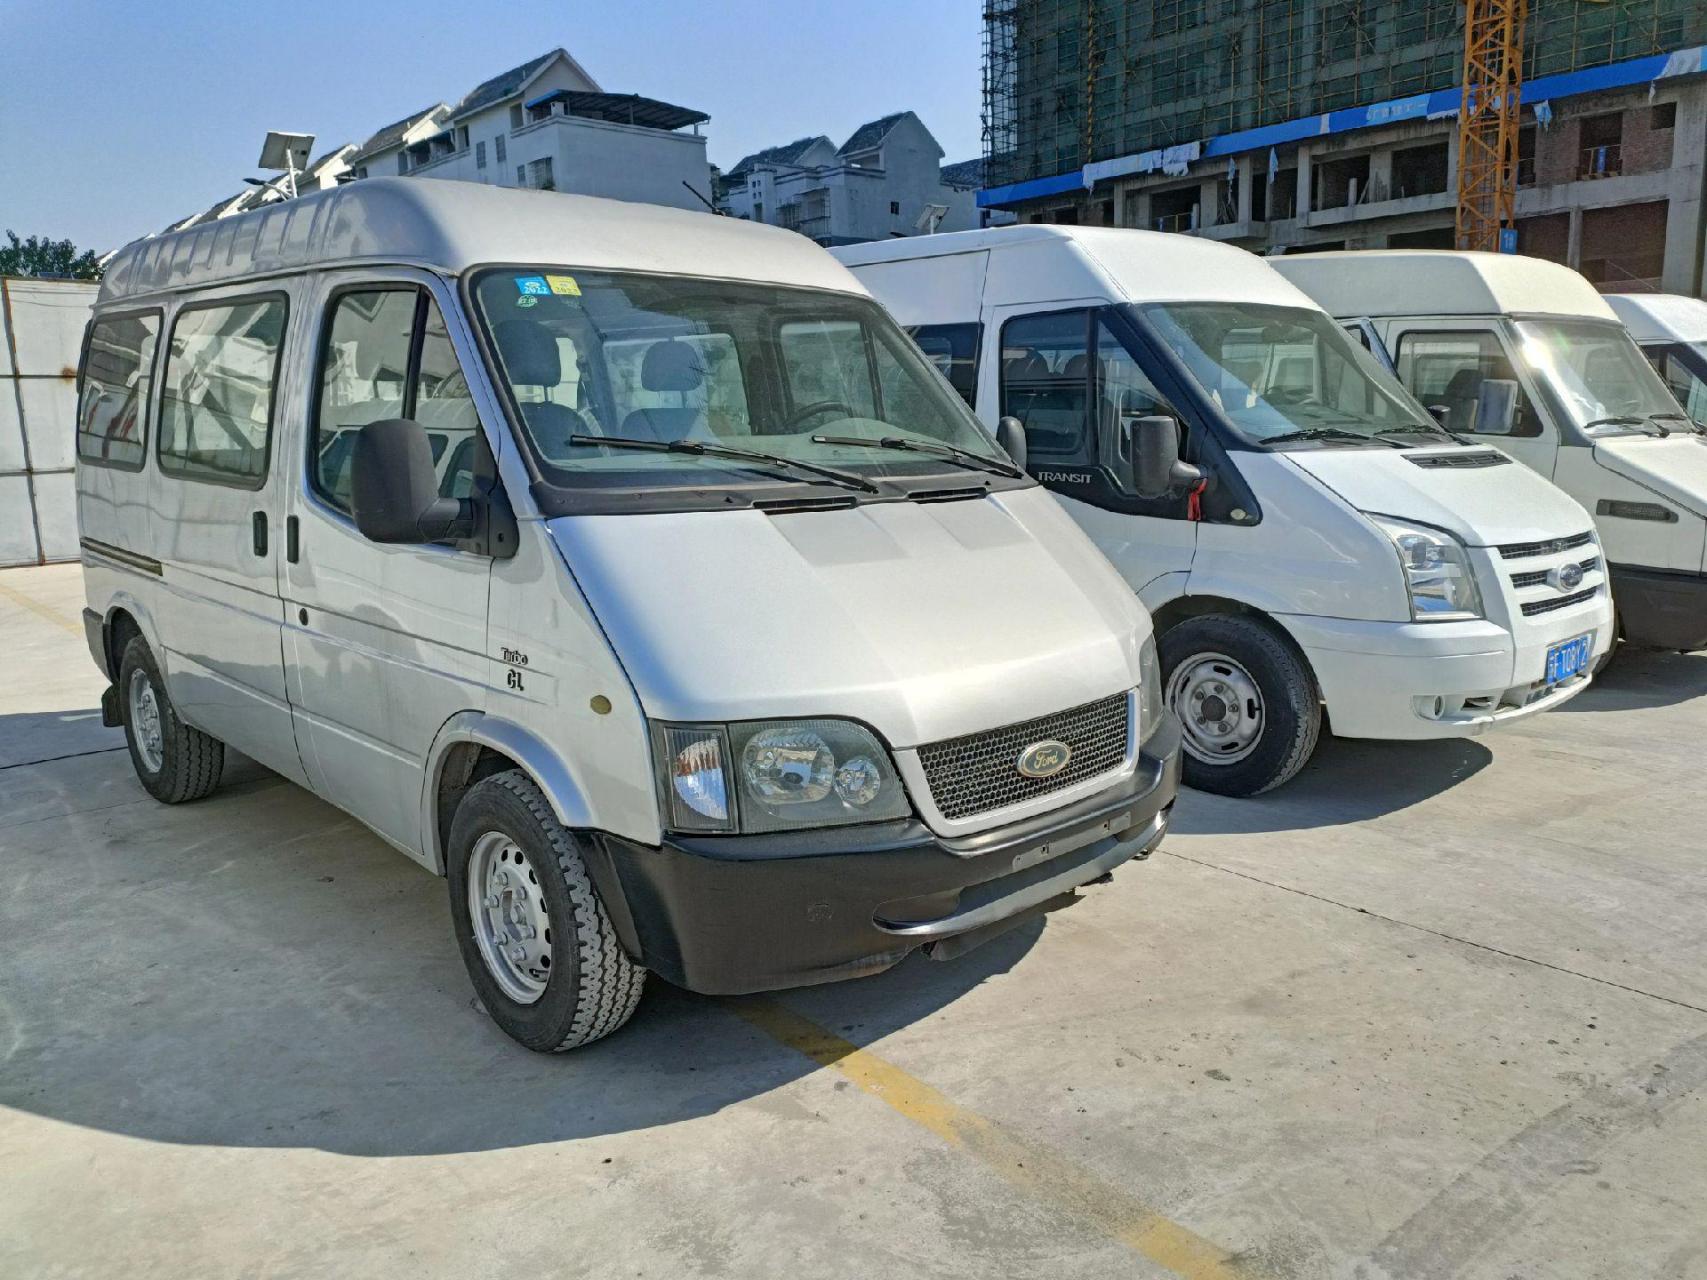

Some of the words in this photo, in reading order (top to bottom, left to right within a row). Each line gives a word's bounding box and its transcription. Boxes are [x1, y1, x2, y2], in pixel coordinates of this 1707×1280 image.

[1038, 471, 1092, 484] TRANSIT
[501, 646, 528, 665] Turbo
[507, 669, 524, 691] GL
[1034, 749, 1059, 769] Ford
